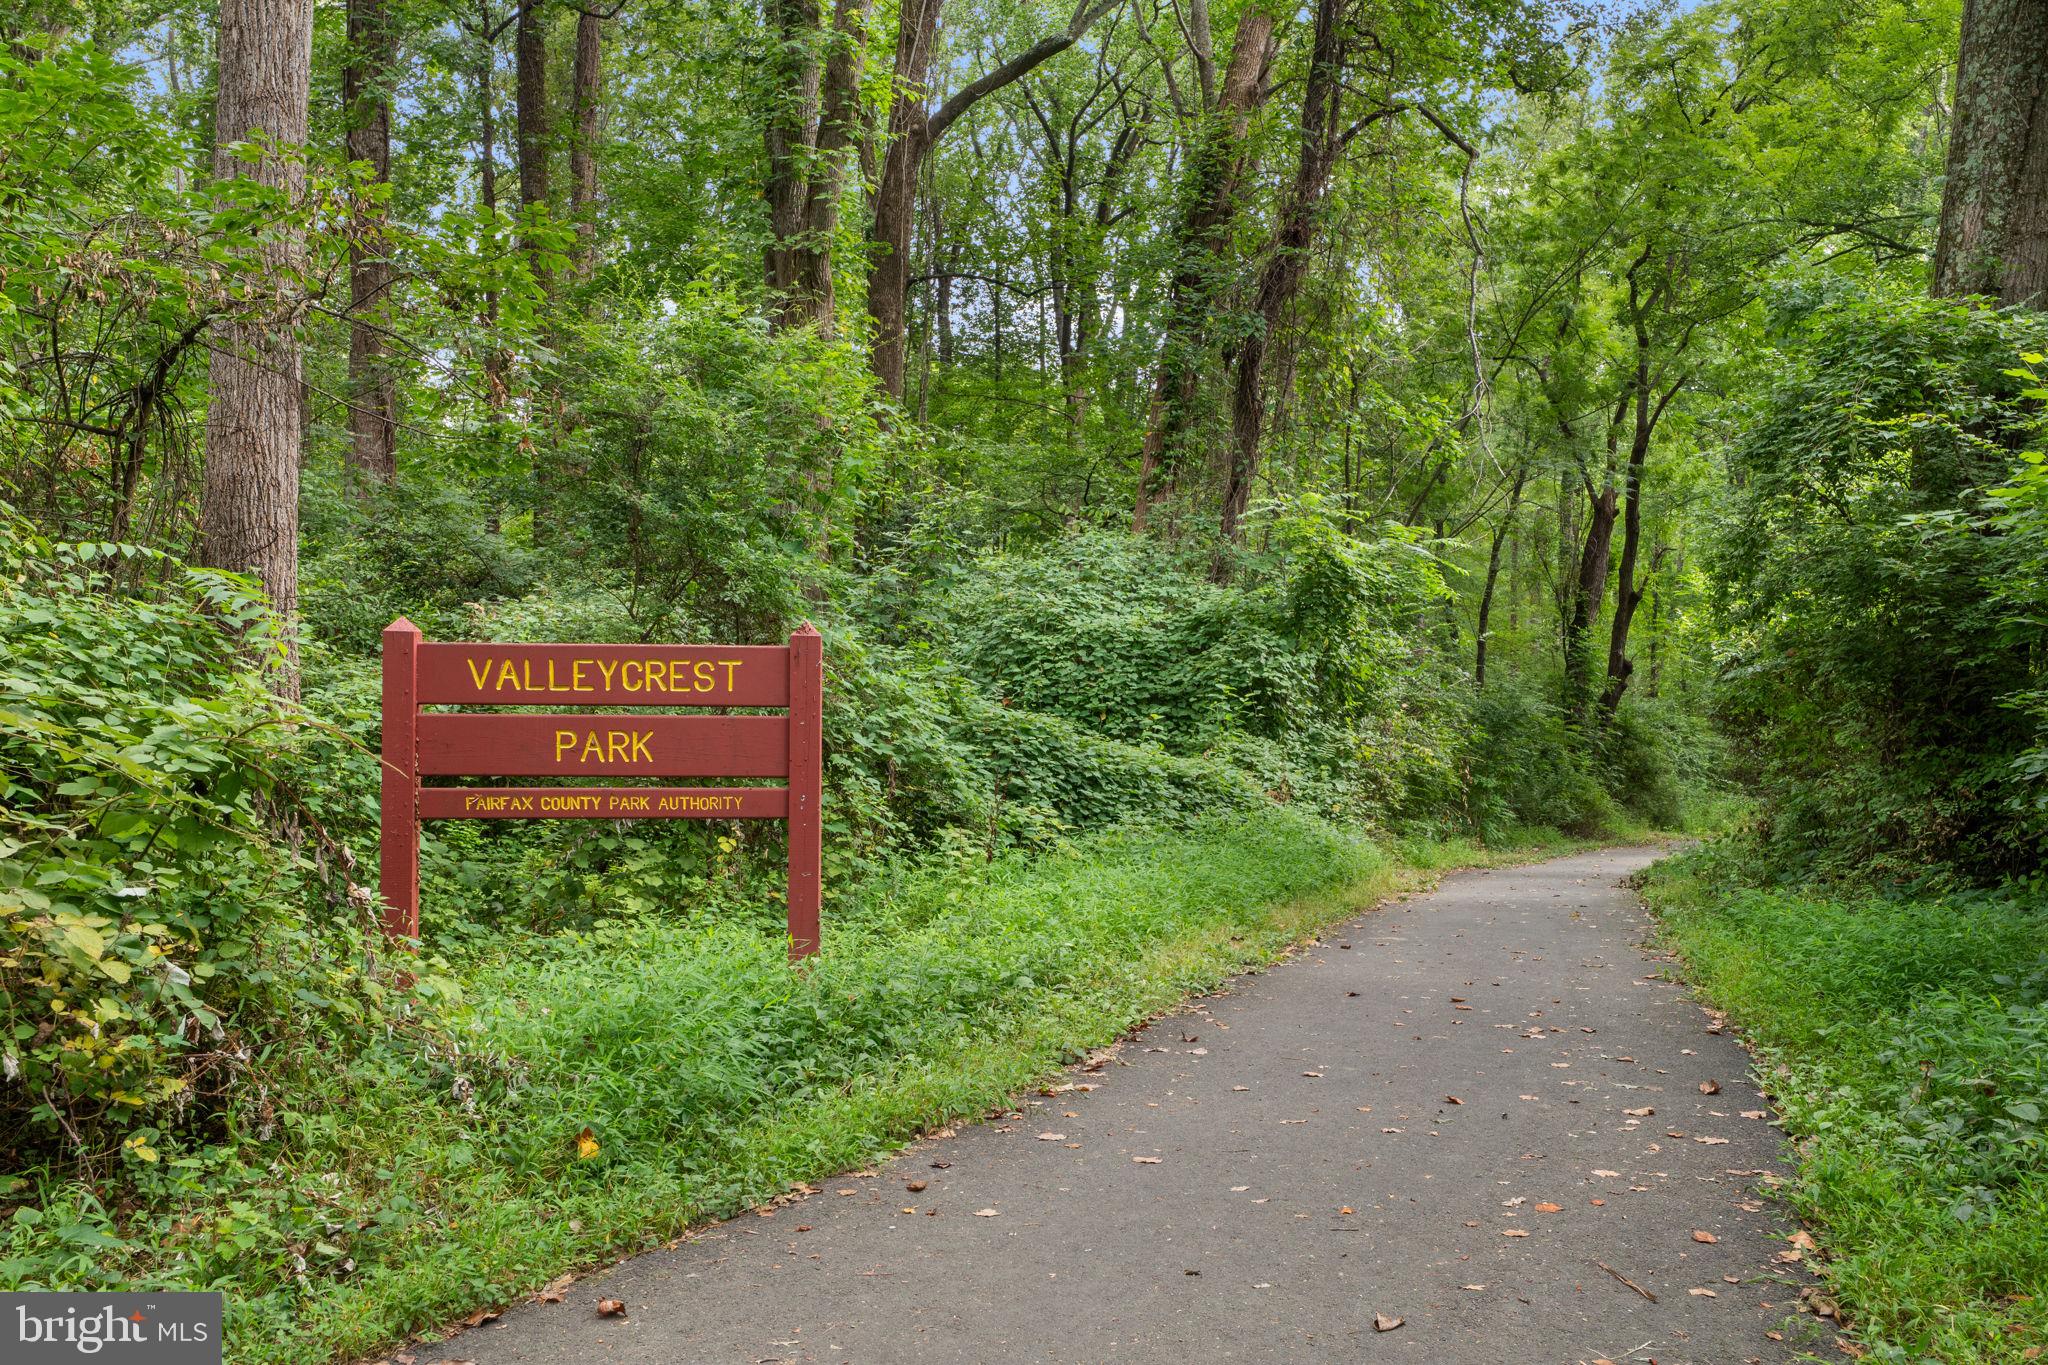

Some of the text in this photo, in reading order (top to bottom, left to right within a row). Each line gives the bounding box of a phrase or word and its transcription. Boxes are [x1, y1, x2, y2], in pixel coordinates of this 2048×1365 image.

[467, 658, 744, 693] VALLEYCREST
[555, 730, 655, 763] PARK
[465, 796, 744, 811] FAIRFAX COUNTY PARK AUTHORITY
